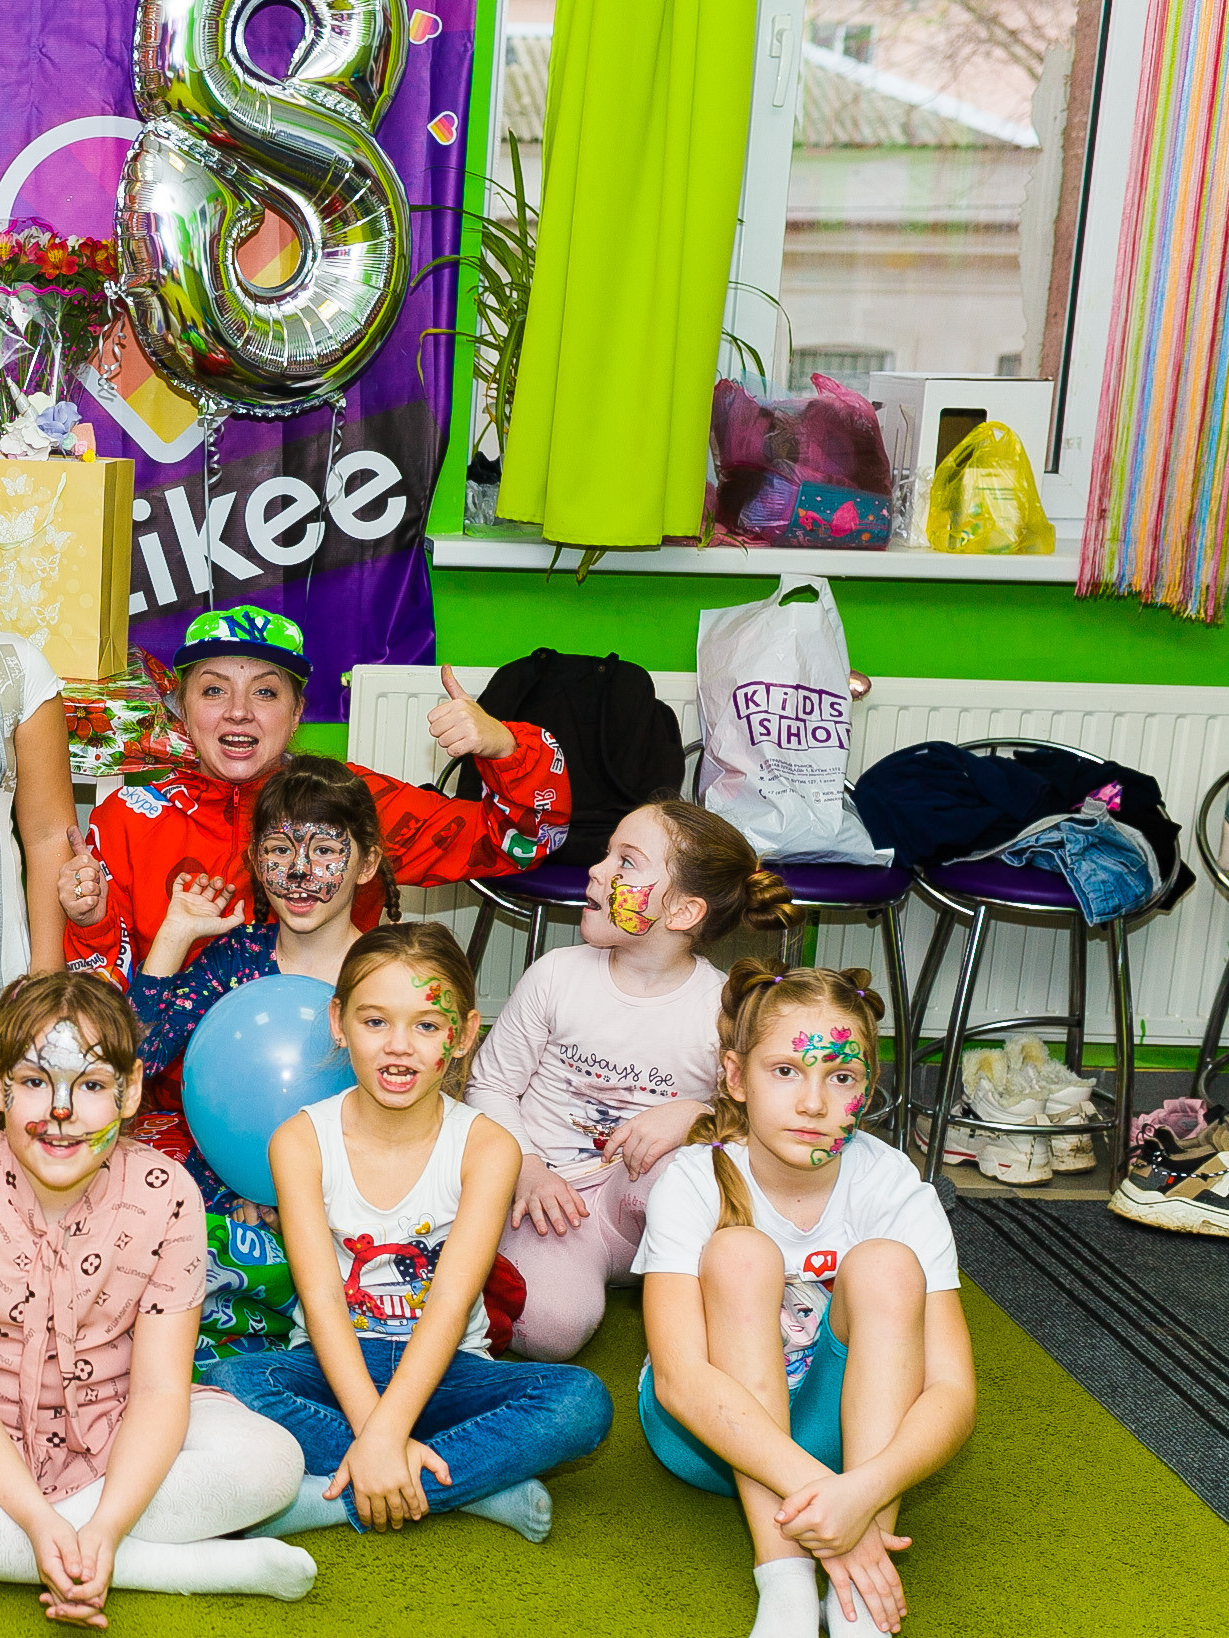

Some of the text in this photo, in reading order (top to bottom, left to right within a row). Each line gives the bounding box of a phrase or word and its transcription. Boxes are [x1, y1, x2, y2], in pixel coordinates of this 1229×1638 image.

[129, 450, 407, 616] ikee
[219, 610, 271, 642] NY
[121, 785, 160, 816] Skype
[559, 1044, 675, 1087] always be
